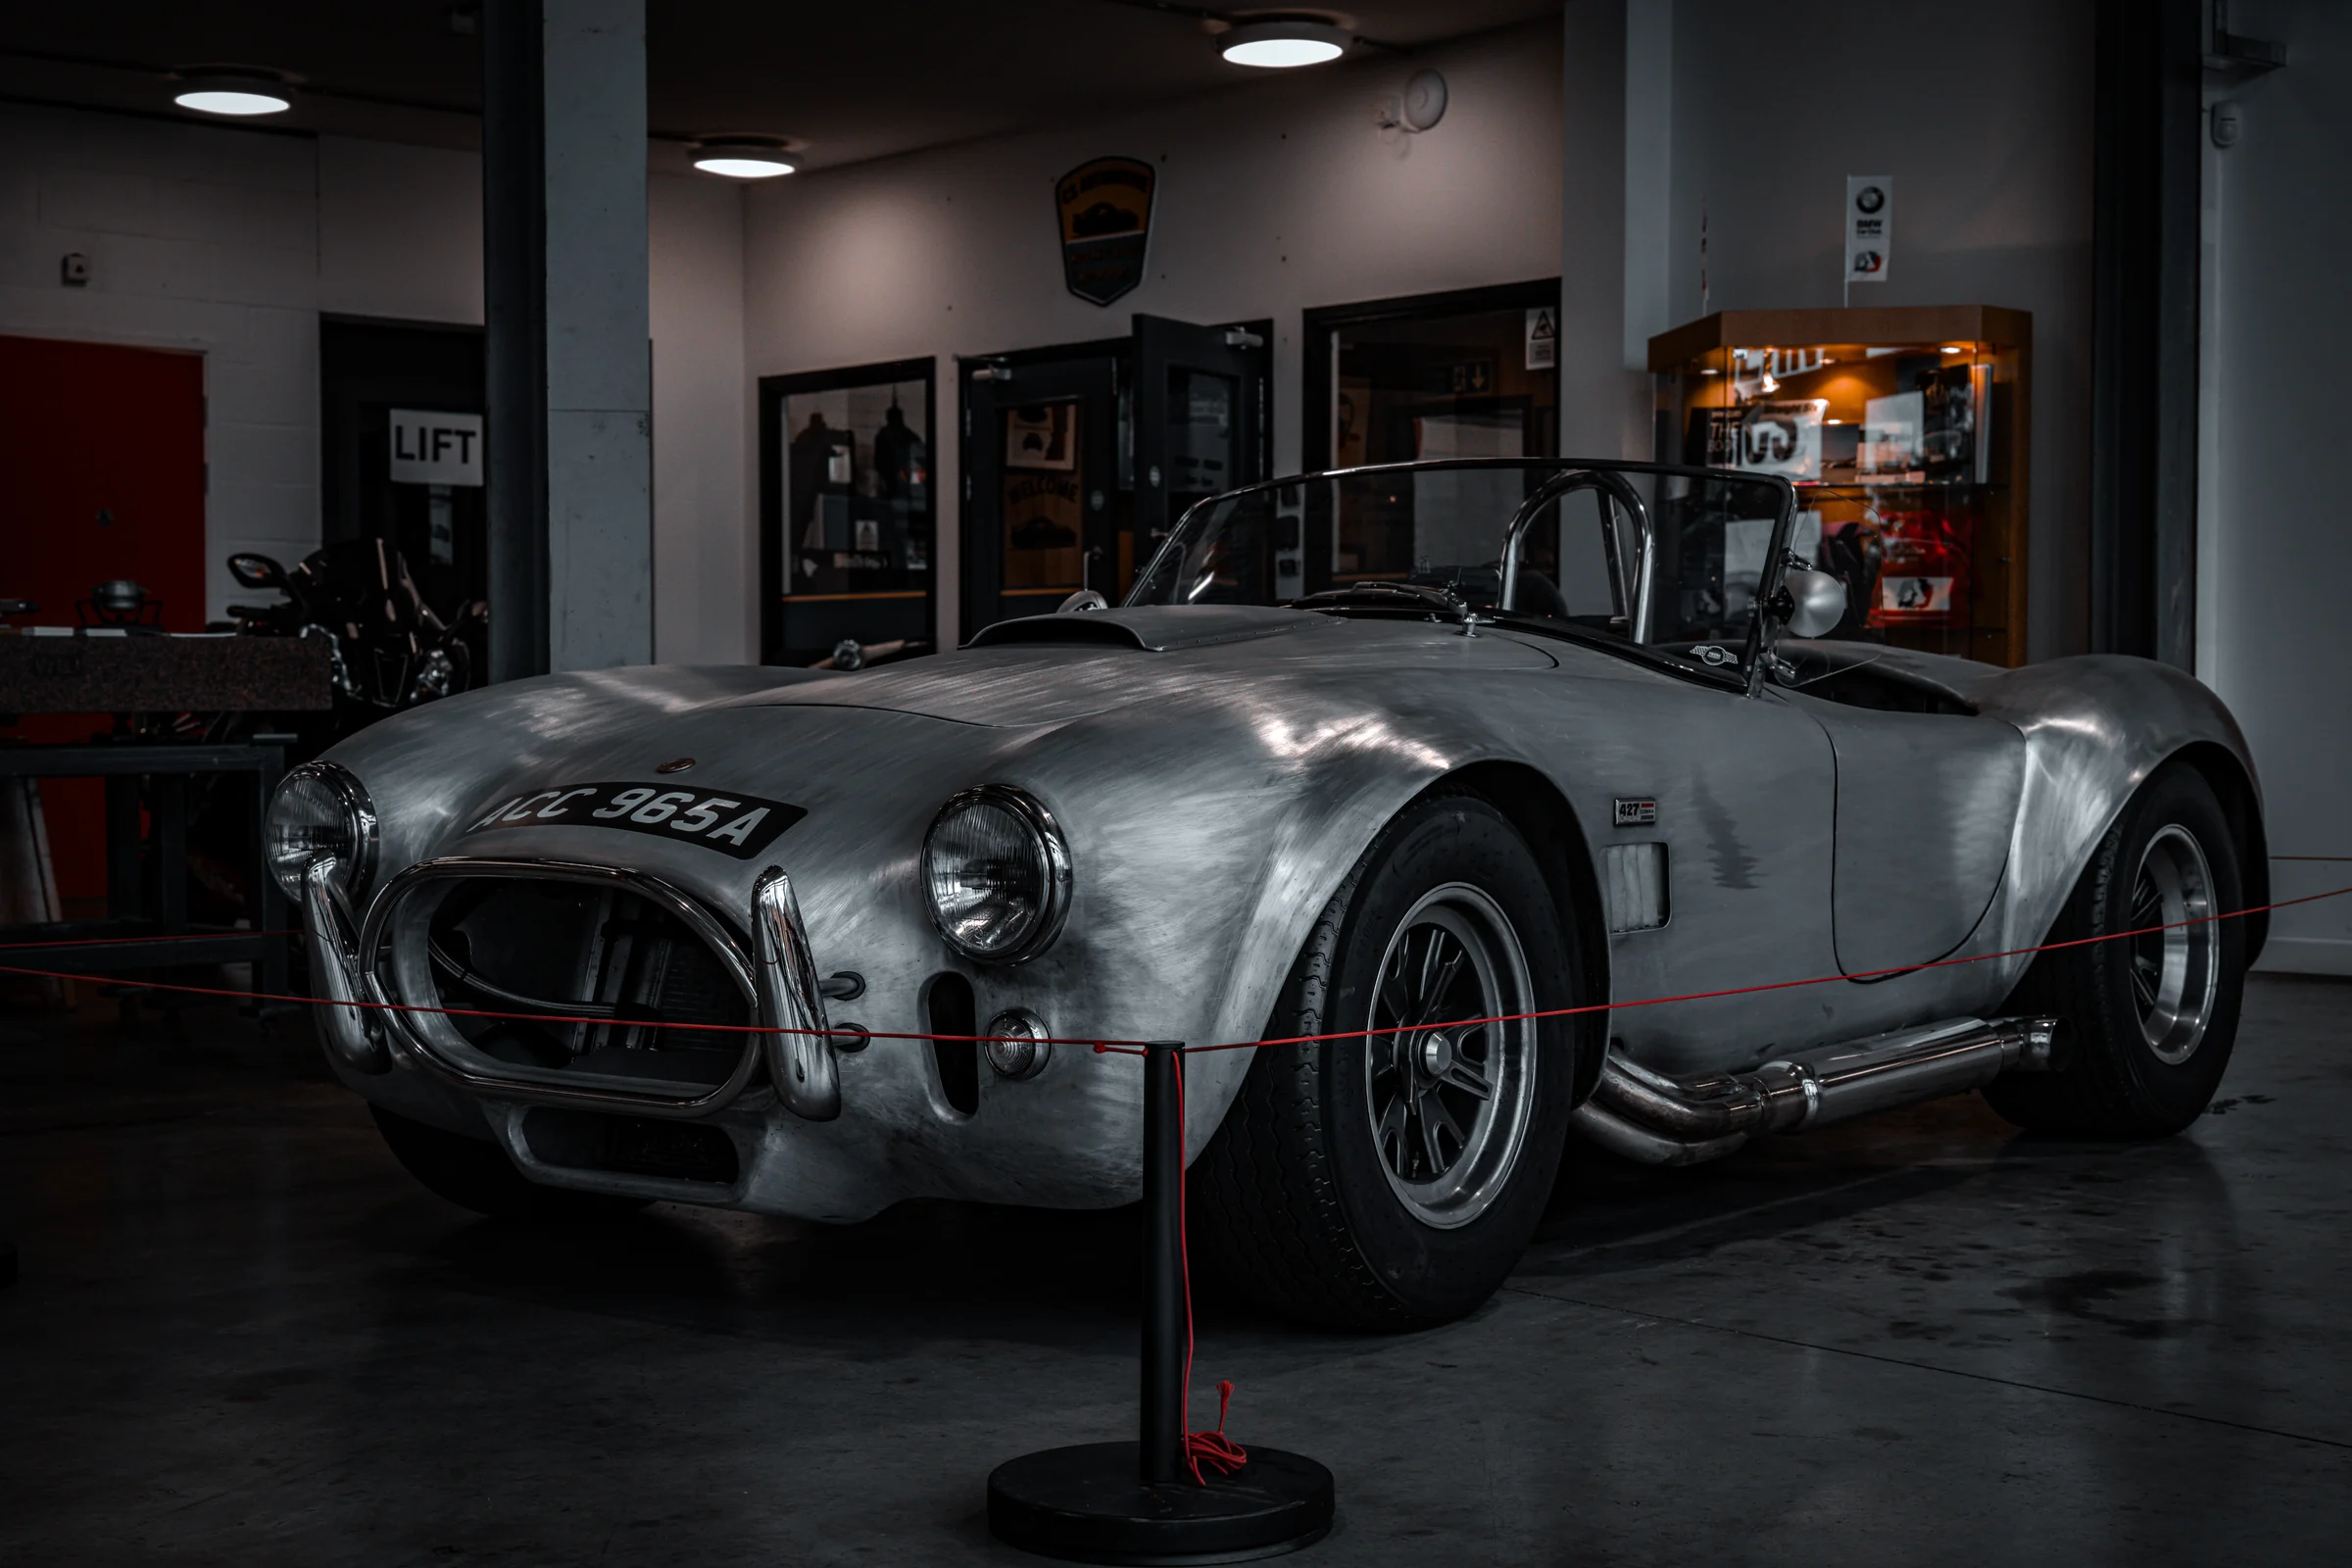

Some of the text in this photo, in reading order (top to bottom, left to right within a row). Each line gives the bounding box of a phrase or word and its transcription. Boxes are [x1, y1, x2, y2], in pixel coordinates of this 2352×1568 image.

[1856, 220, 1883, 228] BMW
[395, 425, 476, 464] LIFT
[1008, 475, 1079, 504] WELCOME
[466, 788, 772, 847] ACC 965A
[1619, 803, 1641, 816] 427
